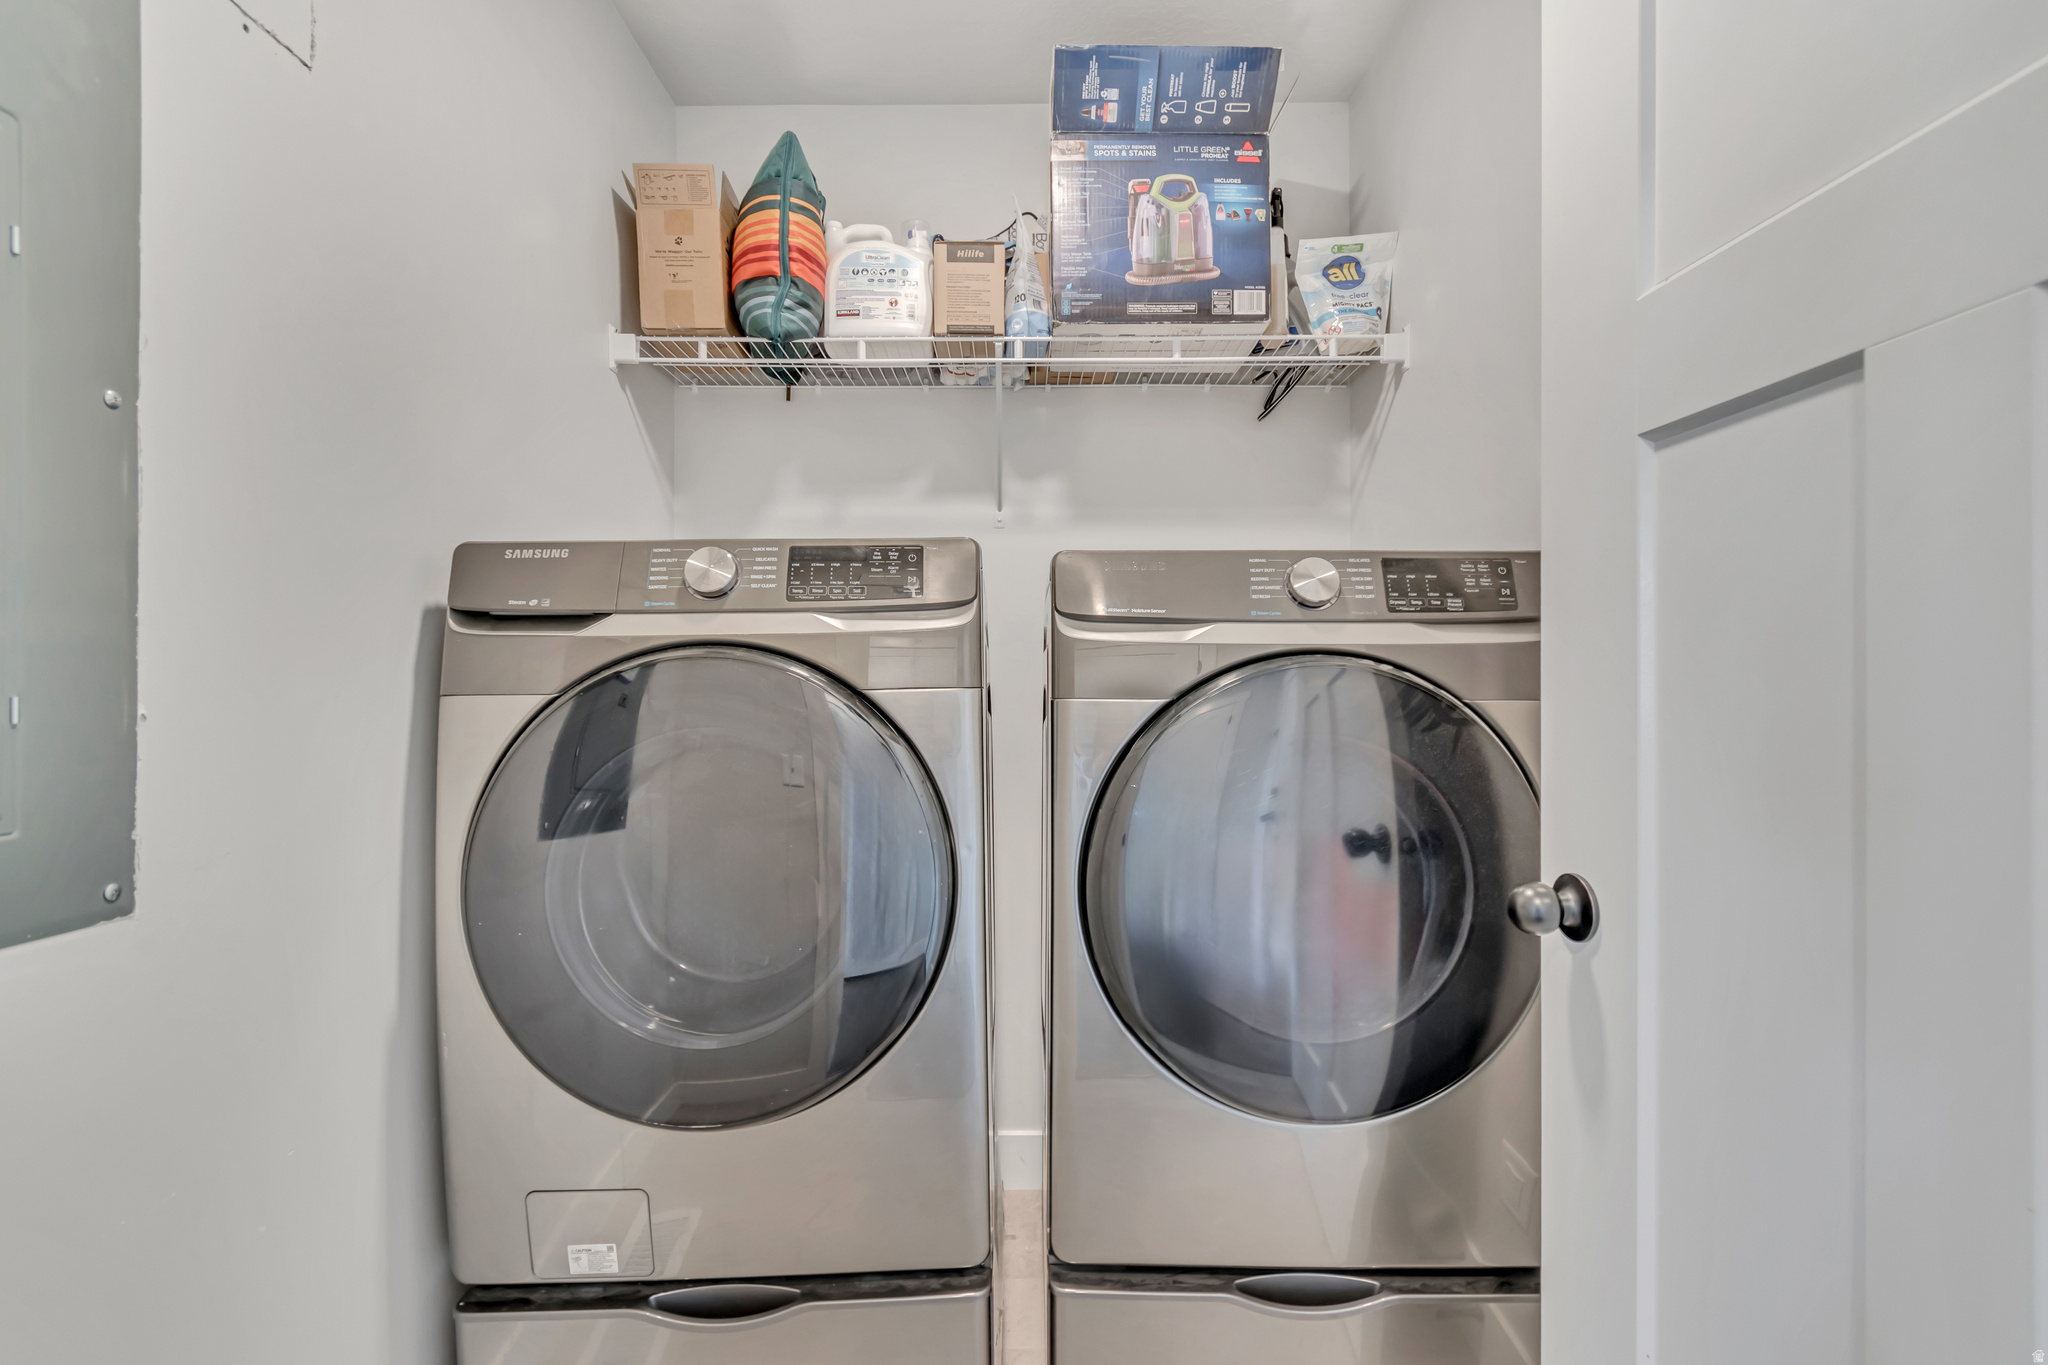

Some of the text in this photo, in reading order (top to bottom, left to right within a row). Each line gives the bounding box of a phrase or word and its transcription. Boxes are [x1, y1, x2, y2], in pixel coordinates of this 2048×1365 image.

[957, 249, 984, 257] Hilife
[1327, 262, 1360, 282] all
[504, 549, 569, 559] SAMSUNG
